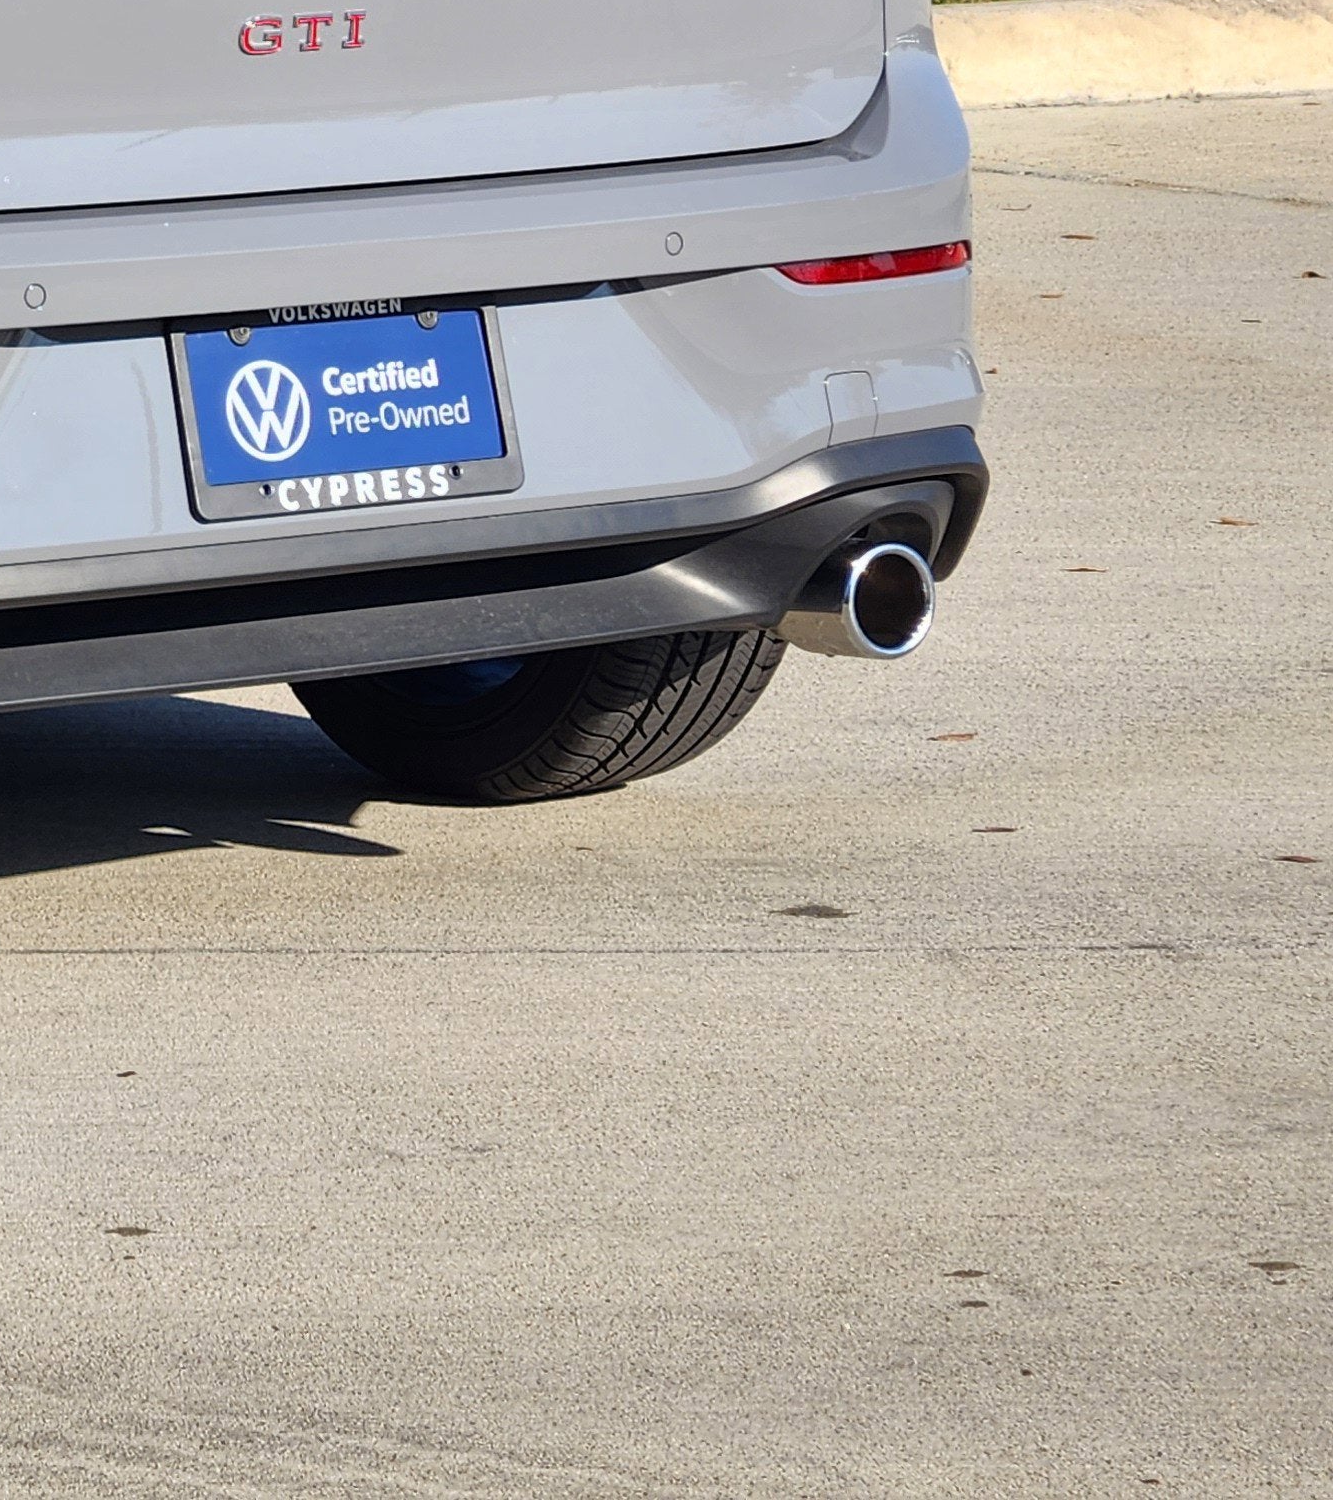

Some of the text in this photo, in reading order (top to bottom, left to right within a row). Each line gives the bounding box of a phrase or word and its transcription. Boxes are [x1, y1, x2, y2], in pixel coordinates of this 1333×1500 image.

[238, 9, 366, 55] GTI
[268, 298, 402, 324] VOLKSWAGEN
[321, 358, 439, 396] Certified
[328, 395, 471, 435] Pre-Owned
[277, 463, 451, 512] CYPRESS
